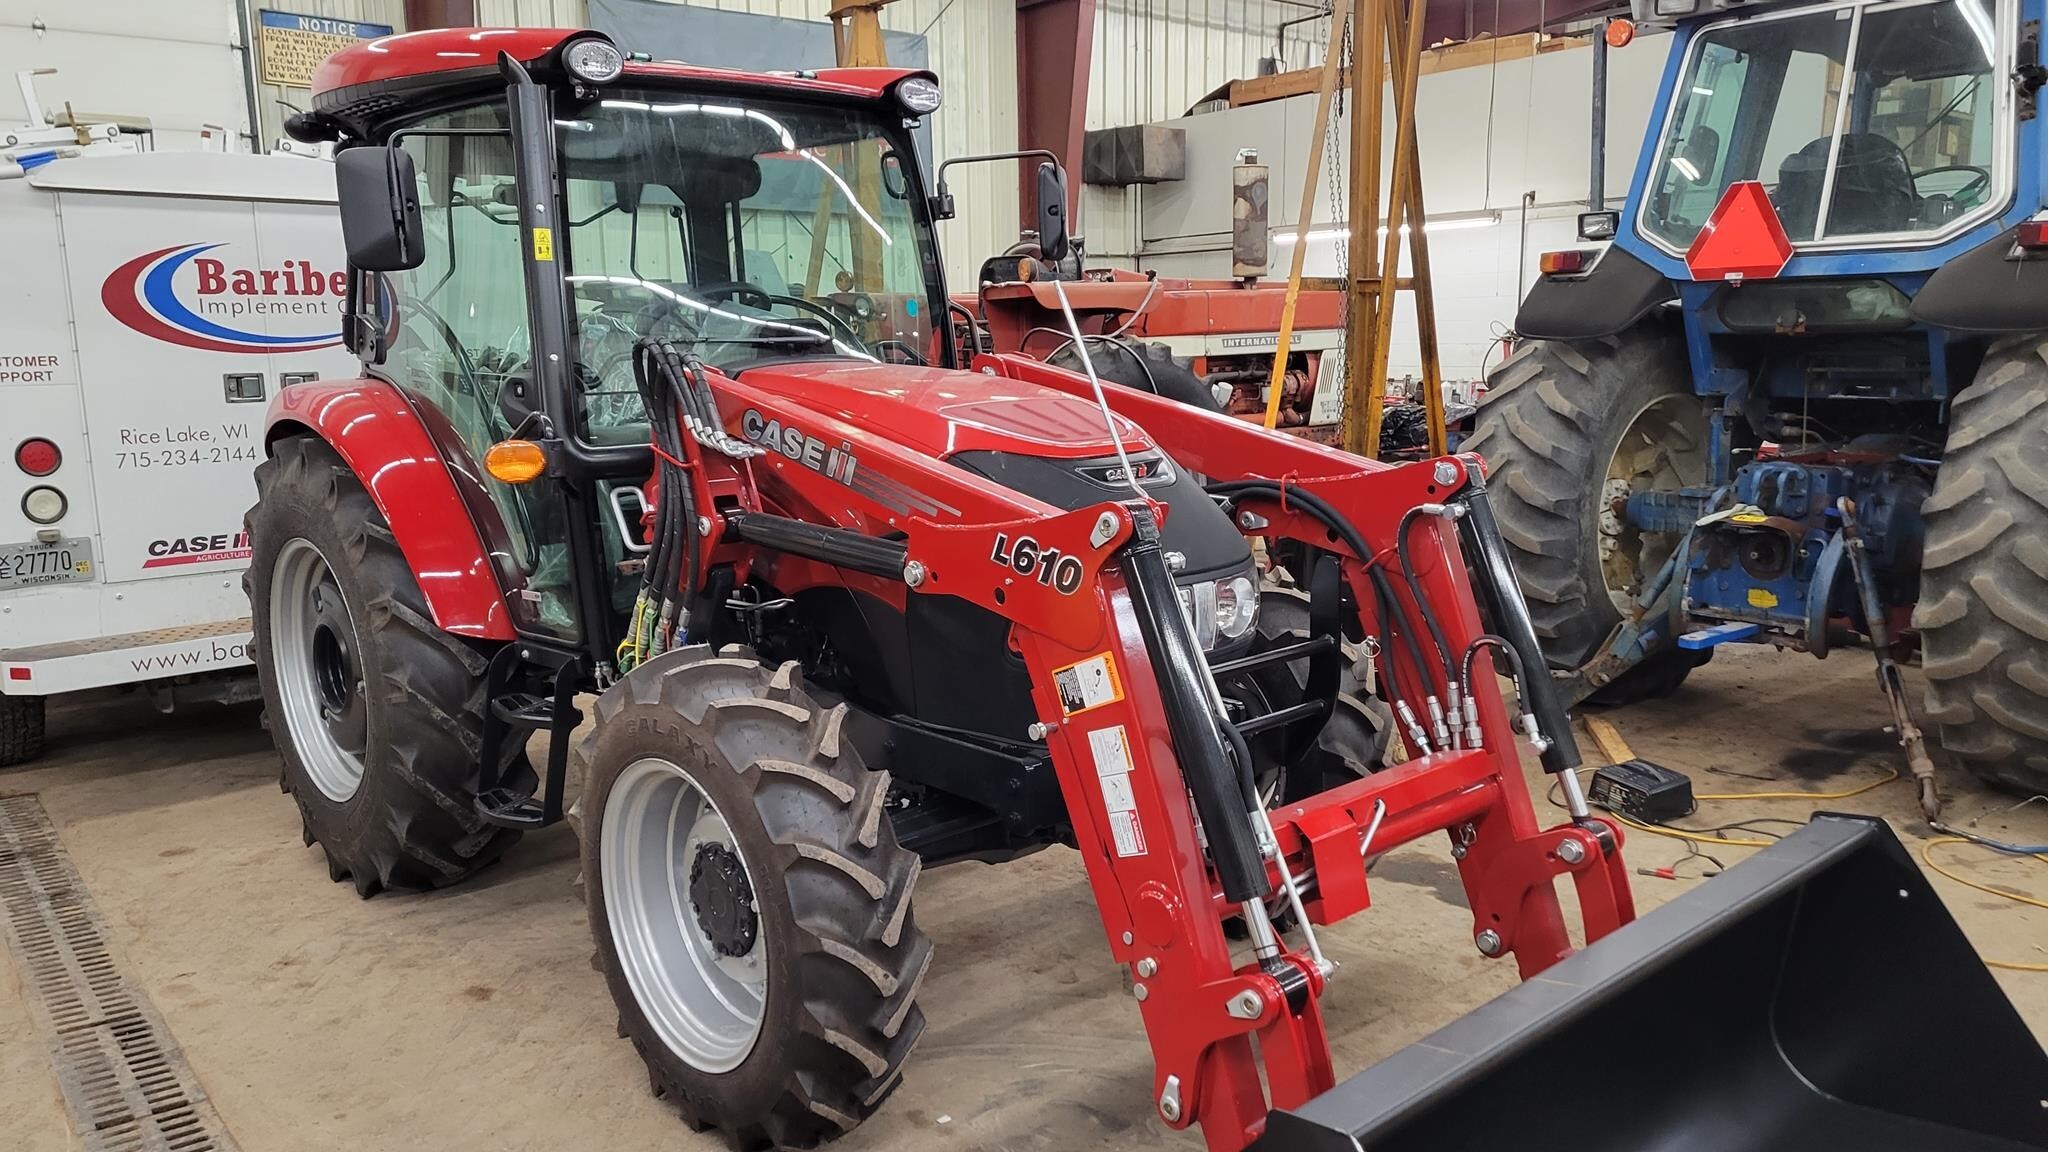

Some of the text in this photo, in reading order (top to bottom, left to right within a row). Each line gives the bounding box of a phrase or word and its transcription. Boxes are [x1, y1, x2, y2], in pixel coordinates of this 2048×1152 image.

[266, 28, 318, 39] CUSTOMERS
[322, 34, 337, 42] ARE
[299, 17, 357, 36] NOTICE
[265, 35, 290, 43] FROM
[293, 38, 330, 48] WAITING
[275, 43, 298, 51] AREA
[268, 56, 294, 65] ROOM
[270, 63, 302, 72] TRYING
[290, 73, 312, 81] OSHA
[194, 259, 347, 297] Baribe
[200, 298, 328, 318] Implement
[0, 355, 59, 367] TOMER
[120, 424, 248, 445] Rice Lake, WI
[741, 408, 826, 472] CASE
[115, 446, 256, 469] 715-234-2144
[30, 543, 53, 551] TRUCK
[148, 534, 227, 557] CASE
[14, 550, 72, 576] 27770
[196, 551, 250, 563] AGRICULTURE
[990, 532, 1084, 596] L610
[21, 573, 70, 584] WISCONSIN
[625, 716, 720, 772] GALAXY
[1132, 819, 1145, 851] DANGER
